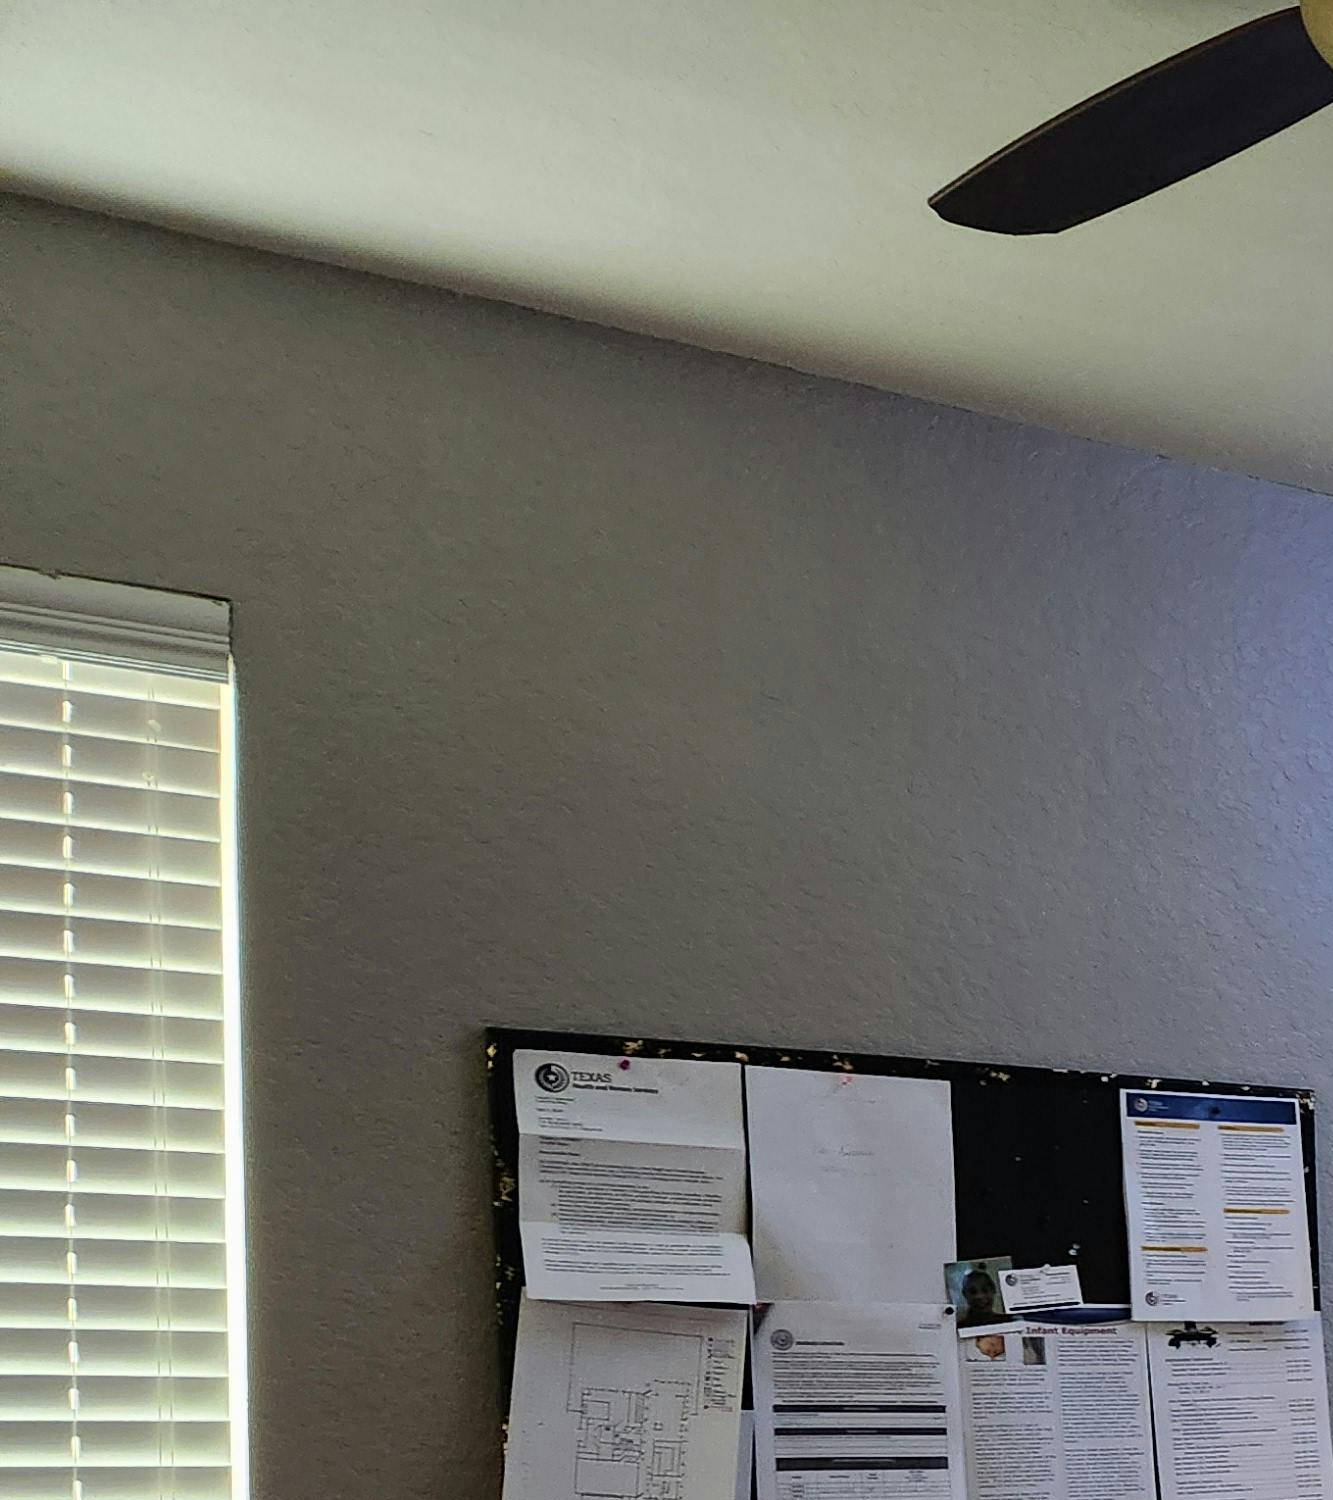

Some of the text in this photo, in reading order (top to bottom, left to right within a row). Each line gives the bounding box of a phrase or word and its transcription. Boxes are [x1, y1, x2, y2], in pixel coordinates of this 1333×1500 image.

[571, 1071, 612, 1083] TEXAS
[1026, 1326, 1117, 1337] Infant Equipment
